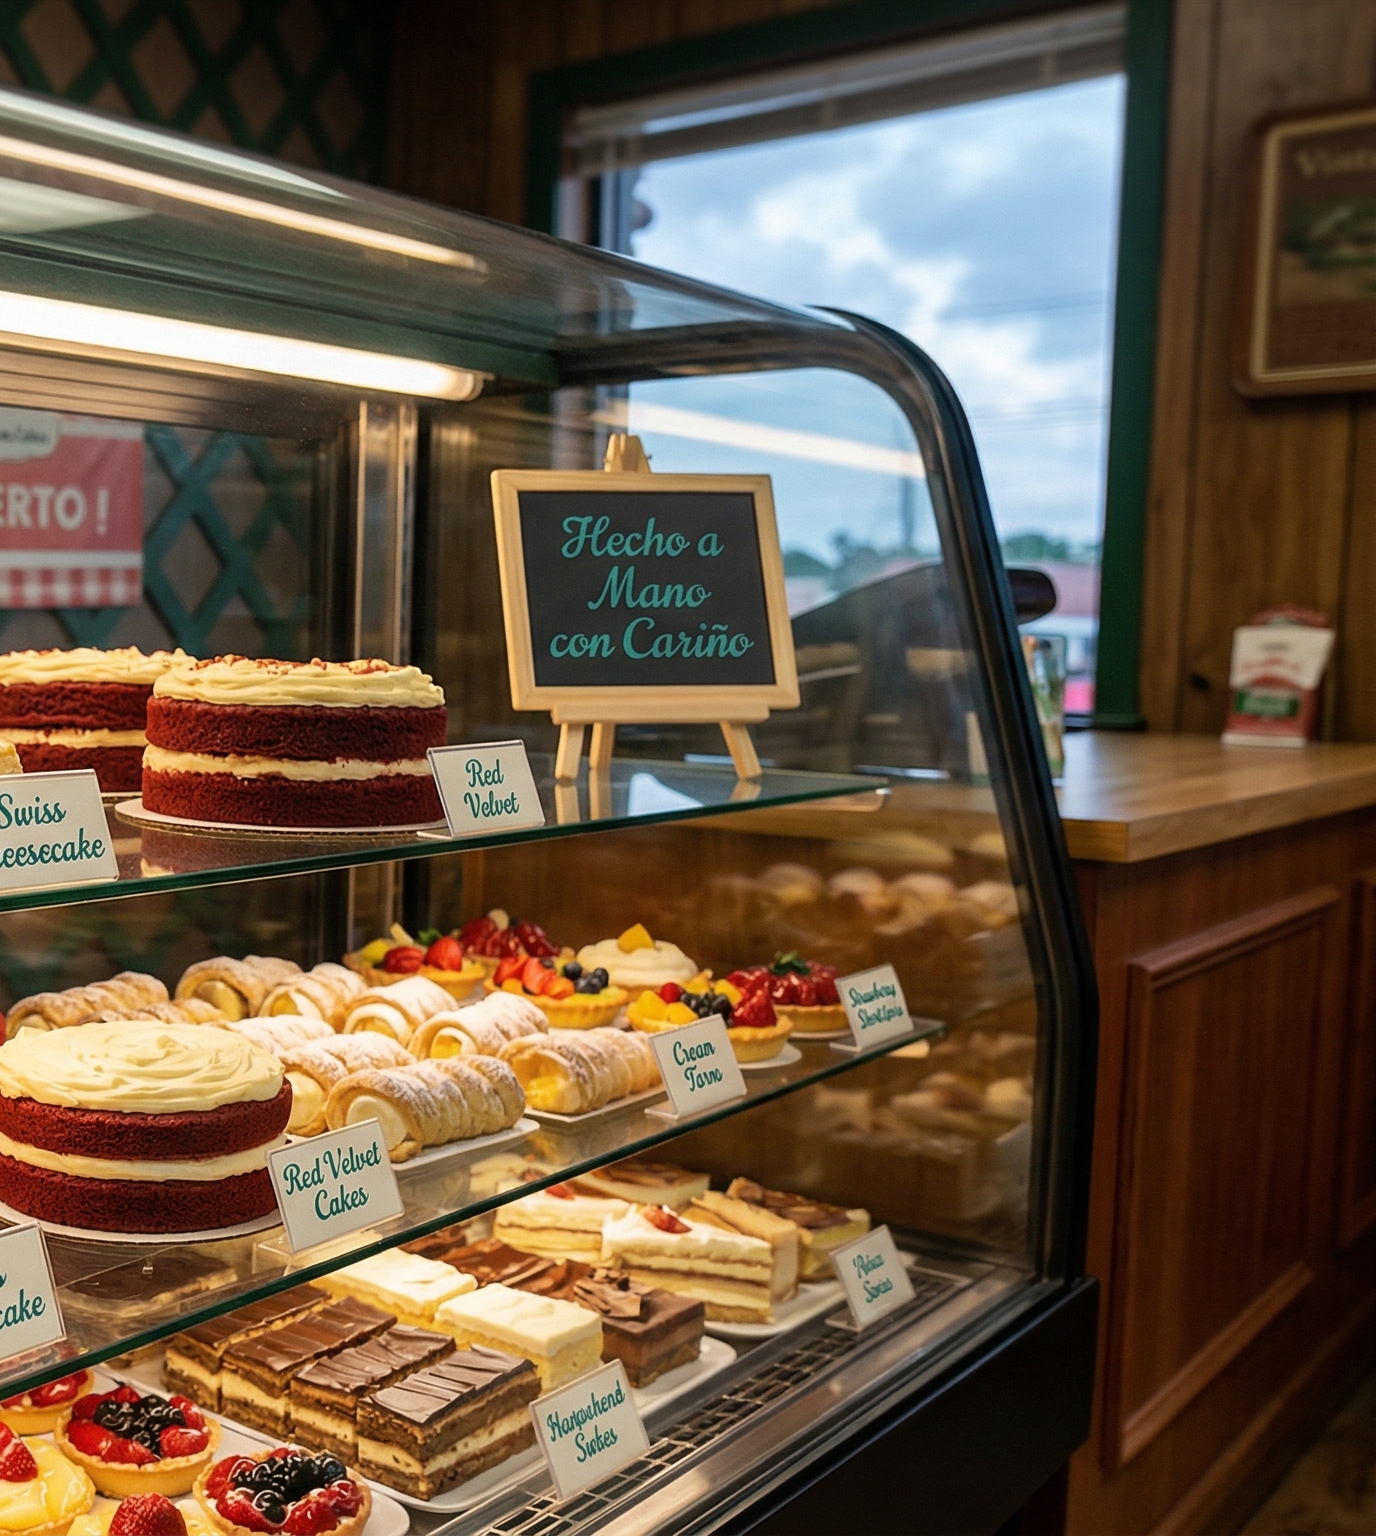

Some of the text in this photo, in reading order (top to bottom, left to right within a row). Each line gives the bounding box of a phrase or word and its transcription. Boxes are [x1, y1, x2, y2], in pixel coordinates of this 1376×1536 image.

[561, 515, 725, 559] Hecho a
[587, 565, 712, 610] Mano
[549, 616, 755, 659] con Cariño
[465, 758, 505, 788] Red
[463, 790, 520, 819] Velvet
[282, 1141, 382, 1195] Red Velvet
[314, 1184, 370, 1221] Cakes
